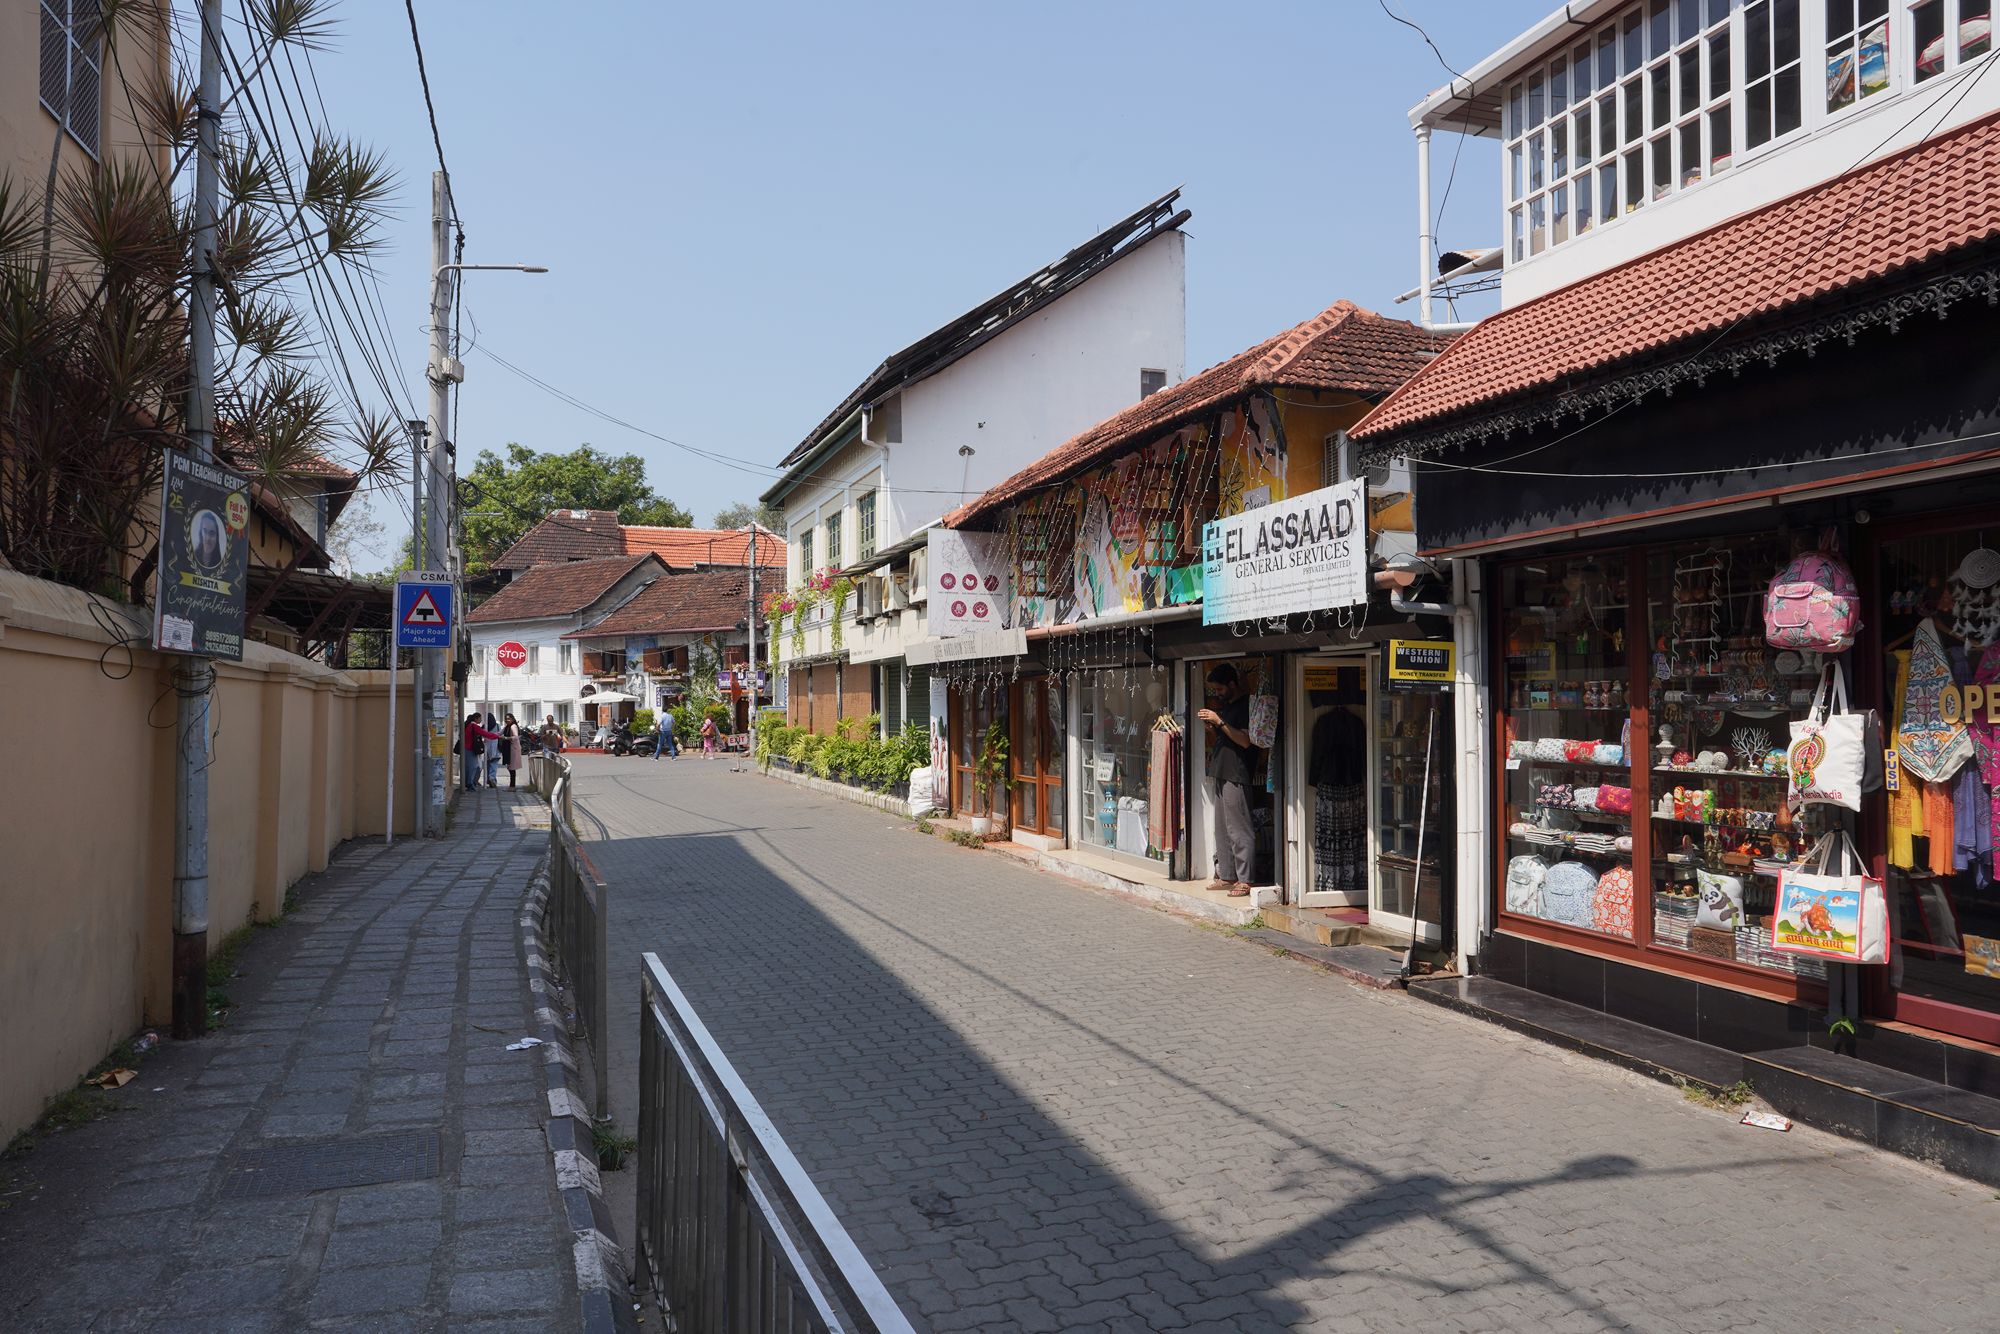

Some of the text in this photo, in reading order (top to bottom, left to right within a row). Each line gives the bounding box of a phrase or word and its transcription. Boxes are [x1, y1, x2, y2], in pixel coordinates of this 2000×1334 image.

[191, 462, 223, 485] TEACHING
[1225, 498, 1354, 564] EL ASSAAD
[1235, 540, 1350, 579] GENERAL SERVICES
[1302, 560, 1350, 576] PRIVATE LIMITED
[192, 576, 219, 590] NISHITA
[420, 573, 452, 582] CSML
[167, 584, 242, 618] Congratulations
[403, 628, 446, 636] Major Road
[498, 650, 526, 660] STOP
[1396, 647, 1441, 657] WESTERN
[1410, 656, 1441, 664] UNION
[729, 736, 745, 744] EXIT
[1887, 751, 1898, 789] PUSH
[1822, 789, 1843, 800] India
